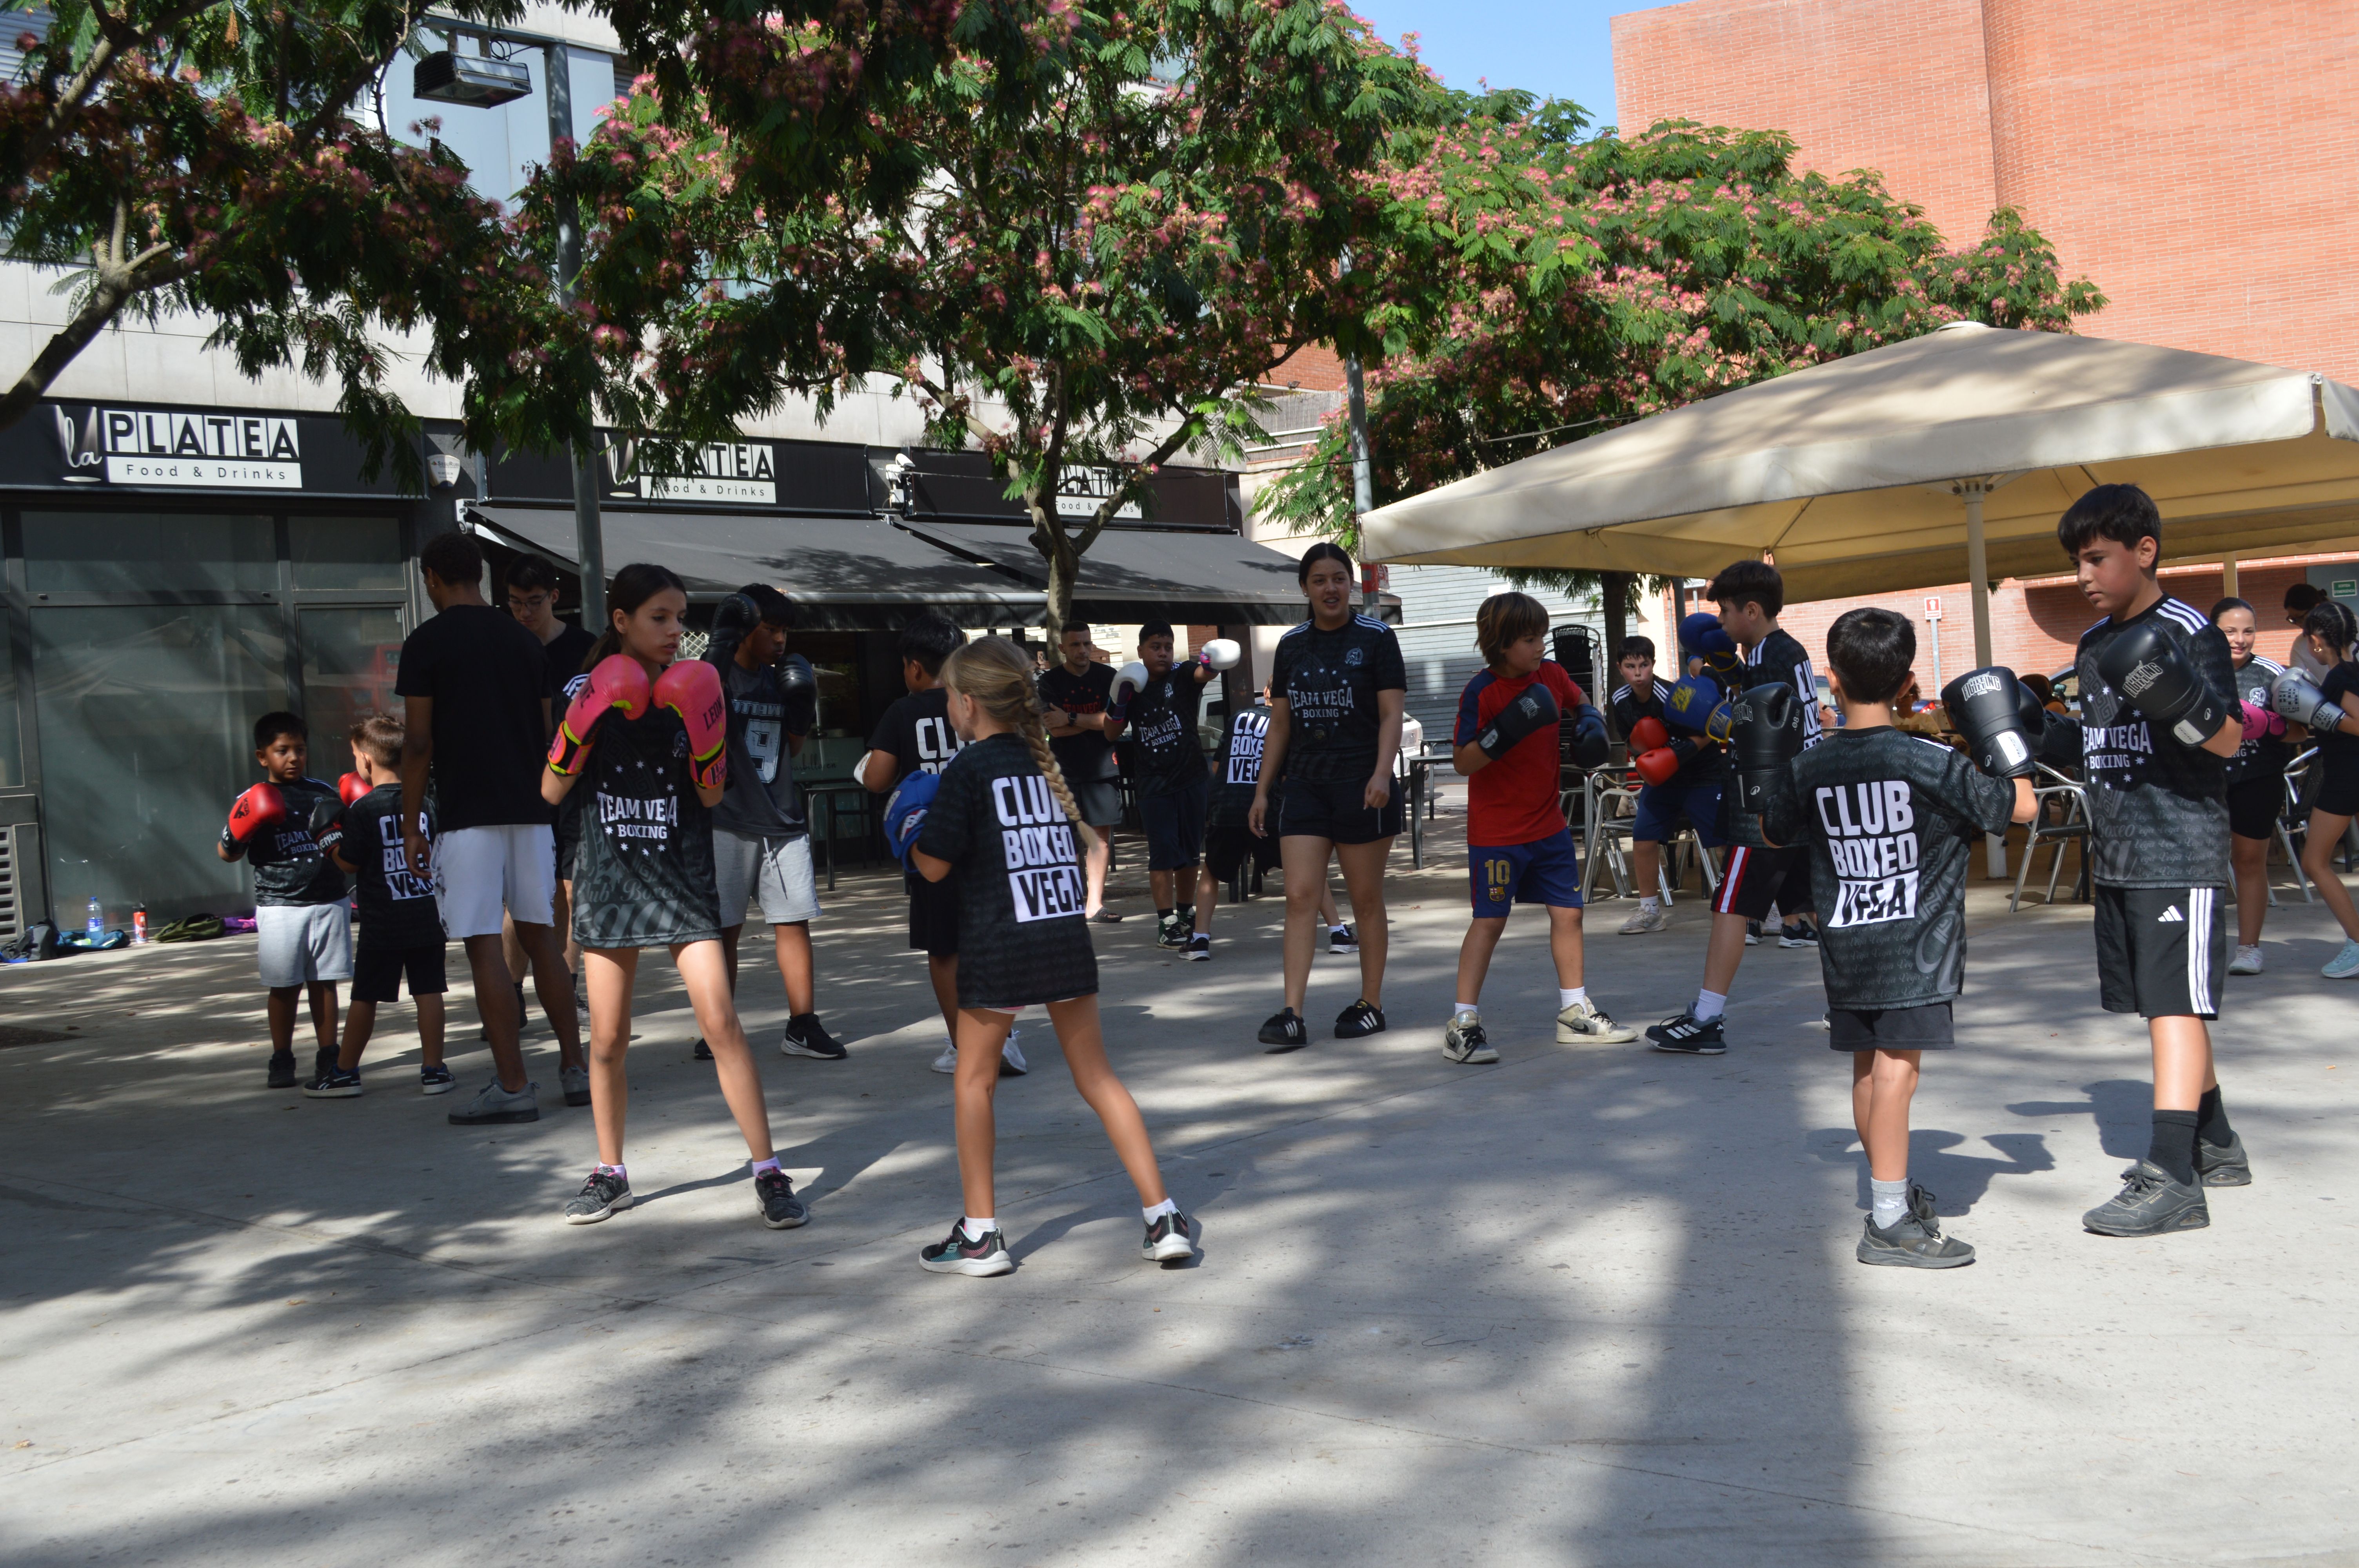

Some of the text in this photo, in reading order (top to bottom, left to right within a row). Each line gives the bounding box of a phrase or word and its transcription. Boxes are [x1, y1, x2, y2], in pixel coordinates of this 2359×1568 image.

[108, 413, 300, 459] PLATEA
[126, 464, 285, 480] Food & Drinks
[700, 485, 706, 494] &
[717, 485, 765, 497] Drinks
[1287, 686, 1354, 710] TEAM VEGA
[703, 693, 724, 731] LEON
[1302, 708, 1339, 719] BOXING
[1139, 714, 1182, 742] TEAM VEGA
[1234, 712, 1270, 738] CLU
[1151, 732, 1176, 747] BOXING
[1230, 735, 1265, 756] BOXE
[2082, 720, 2153, 756] EAM VEGA
[2088, 754, 2131, 769] BOXING
[597, 791, 678, 828] TEAM VEA
[1816, 780, 1914, 836] CLUB
[274, 831, 305, 851] TEAM
[379, 812, 430, 846] CLB
[617, 824, 667, 839] BOXING
[291, 843, 318, 855] BOXIN
[1001, 825, 1077, 869] BOXEO
[1827, 832, 1918, 878] BOXEO
[1484, 860, 1510, 885] 10
[1841, 877, 1908, 926] VEGA
